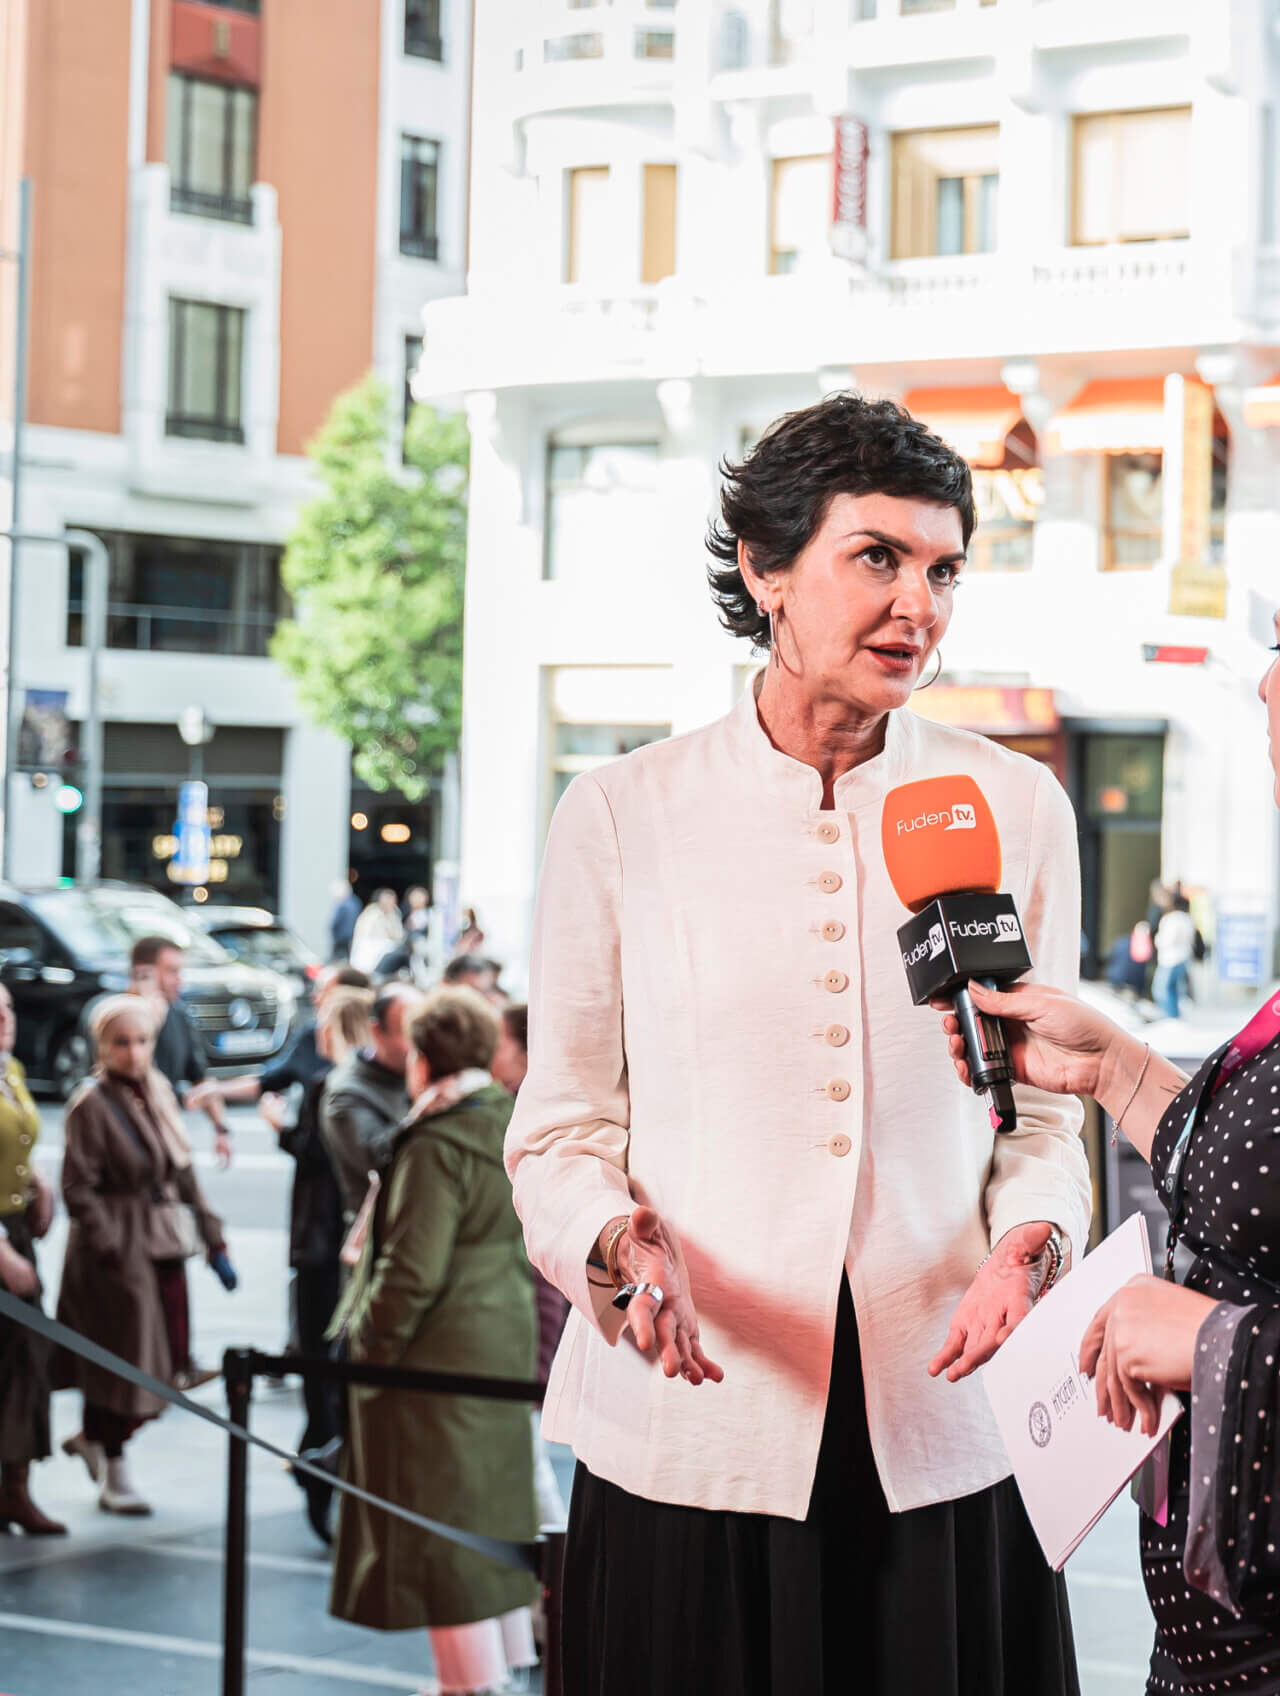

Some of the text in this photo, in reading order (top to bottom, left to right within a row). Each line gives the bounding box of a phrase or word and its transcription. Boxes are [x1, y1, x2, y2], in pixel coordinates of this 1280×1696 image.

[896, 811, 951, 836] Fuden
[949, 920, 999, 937] Fuden
[902, 939, 932, 968] Fuden
